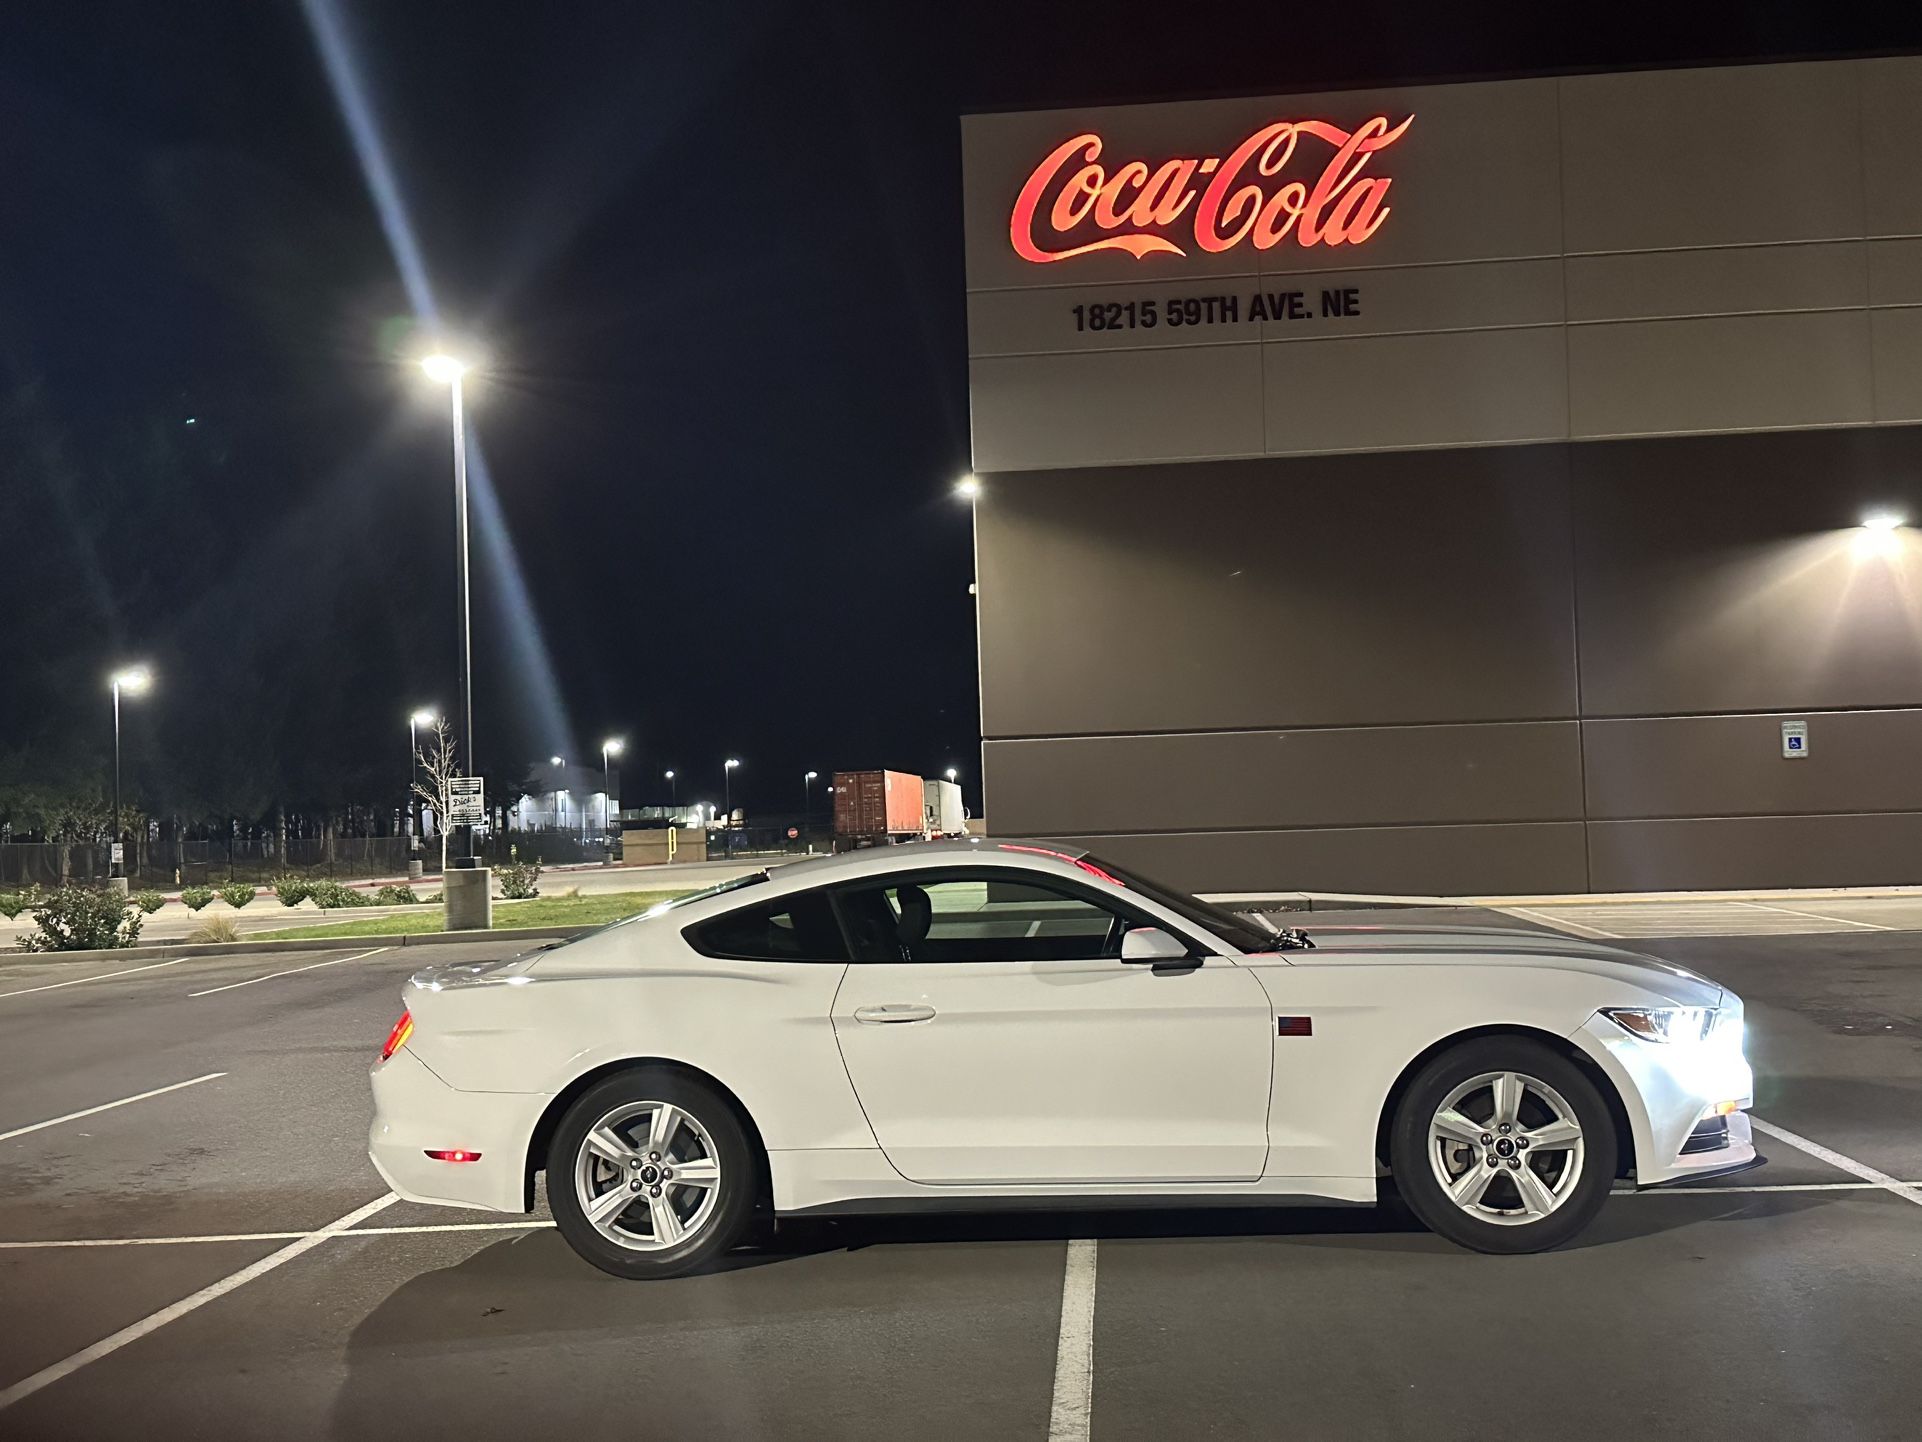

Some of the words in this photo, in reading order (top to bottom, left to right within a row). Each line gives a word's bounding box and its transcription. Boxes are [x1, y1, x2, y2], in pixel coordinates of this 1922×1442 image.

[1010, 113, 1415, 263] Coca-Cola
[1072, 300, 1158, 332] 18215
[1166, 295, 1239, 327] 59TH
[1247, 291, 1313, 322] AVE.
[1321, 288, 1361, 318] NE
